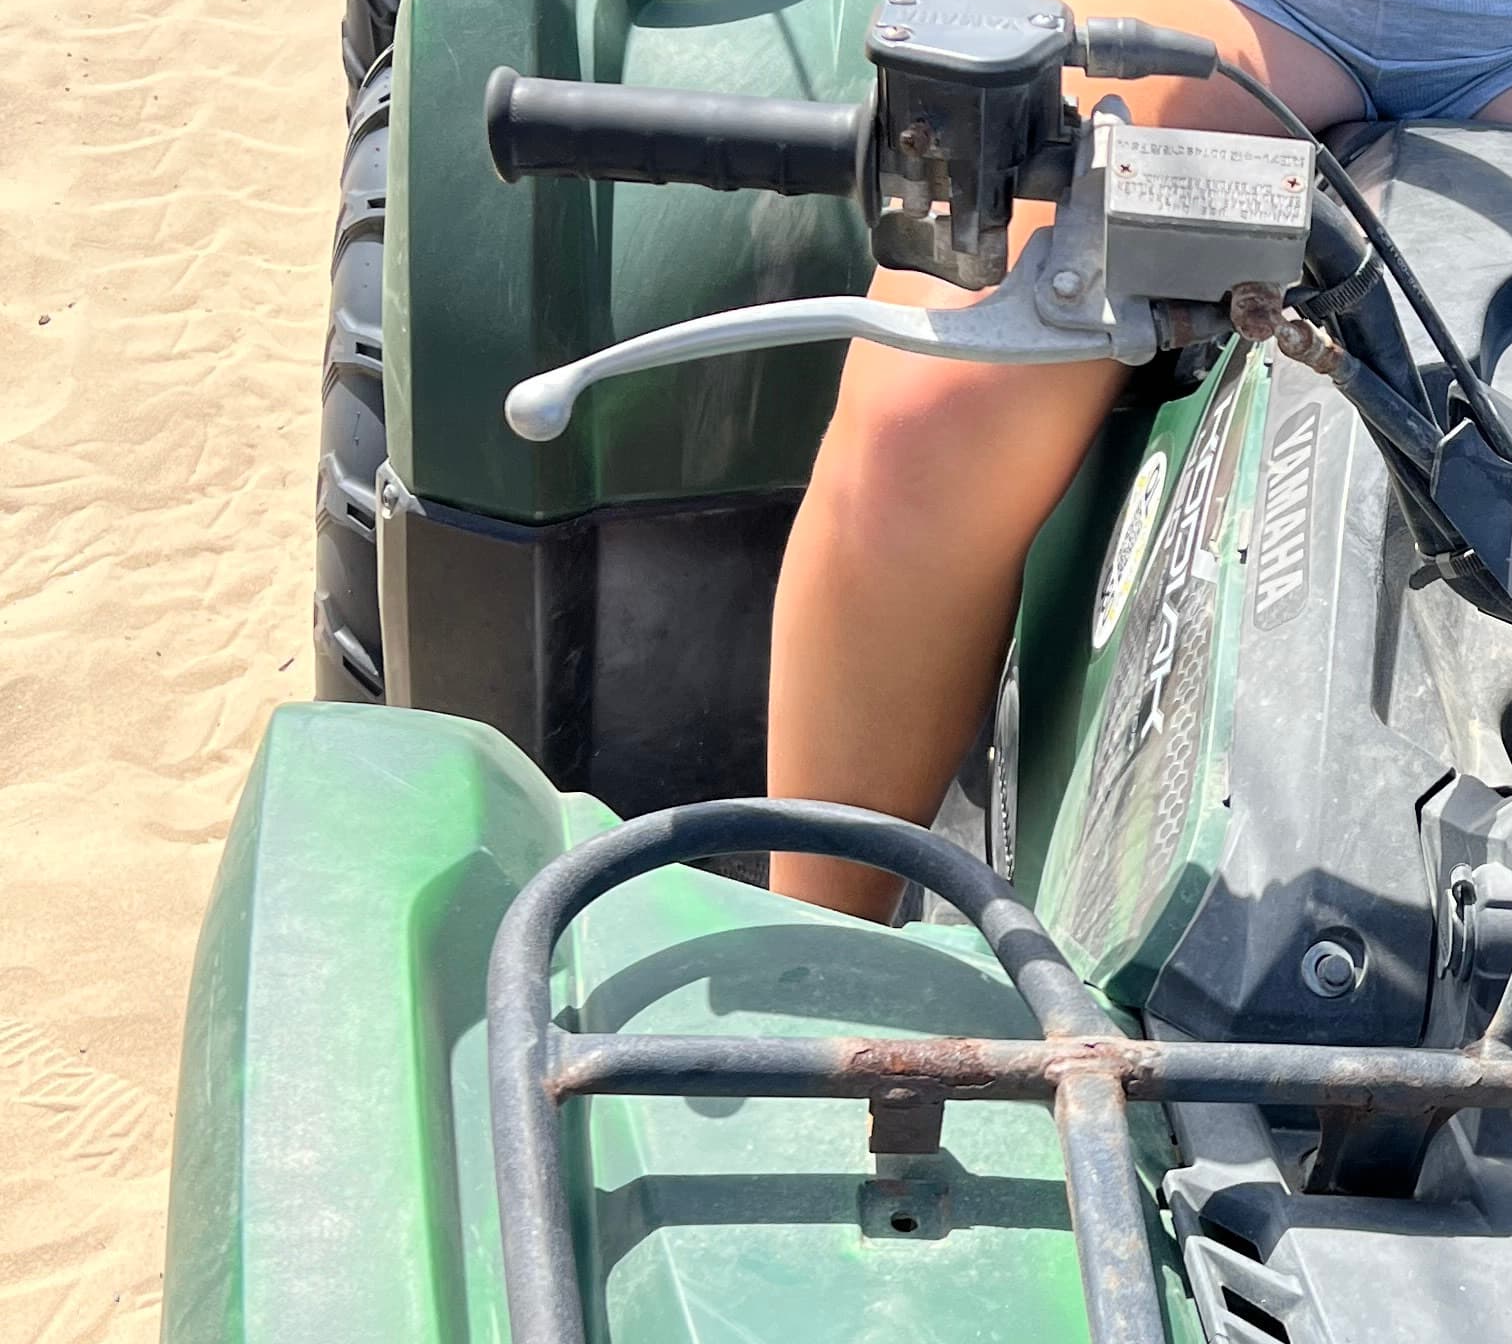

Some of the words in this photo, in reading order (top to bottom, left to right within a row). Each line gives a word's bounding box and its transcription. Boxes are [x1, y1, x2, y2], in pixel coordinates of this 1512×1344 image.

[899, 8, 1021, 31] YAMAHA
[1141, 389, 1235, 740] KODIAK
[1257, 415, 1316, 614] YAMAHA
